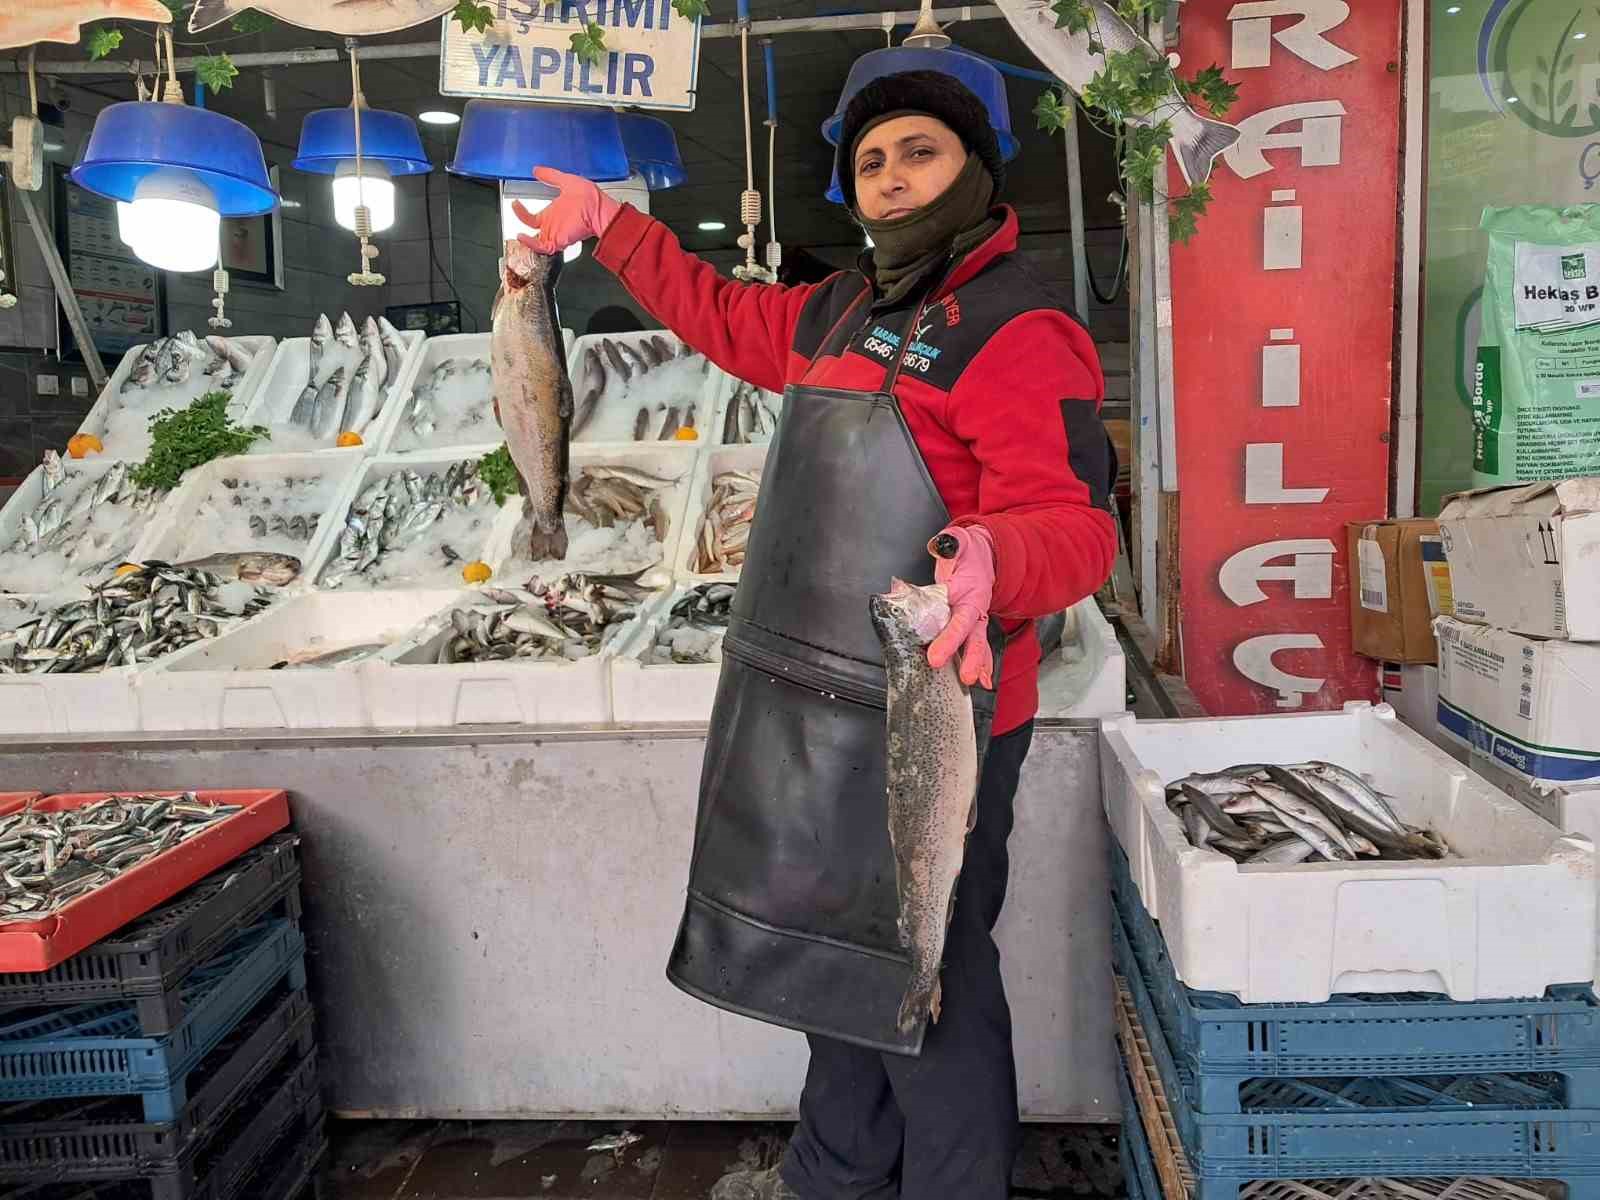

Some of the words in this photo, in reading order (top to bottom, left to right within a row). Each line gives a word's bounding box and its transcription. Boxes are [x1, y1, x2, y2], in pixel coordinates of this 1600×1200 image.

[472, 44, 655, 97] YAPILIR
[871, 326, 901, 348] KARADE
[1472, 362, 1484, 405] Bordo
